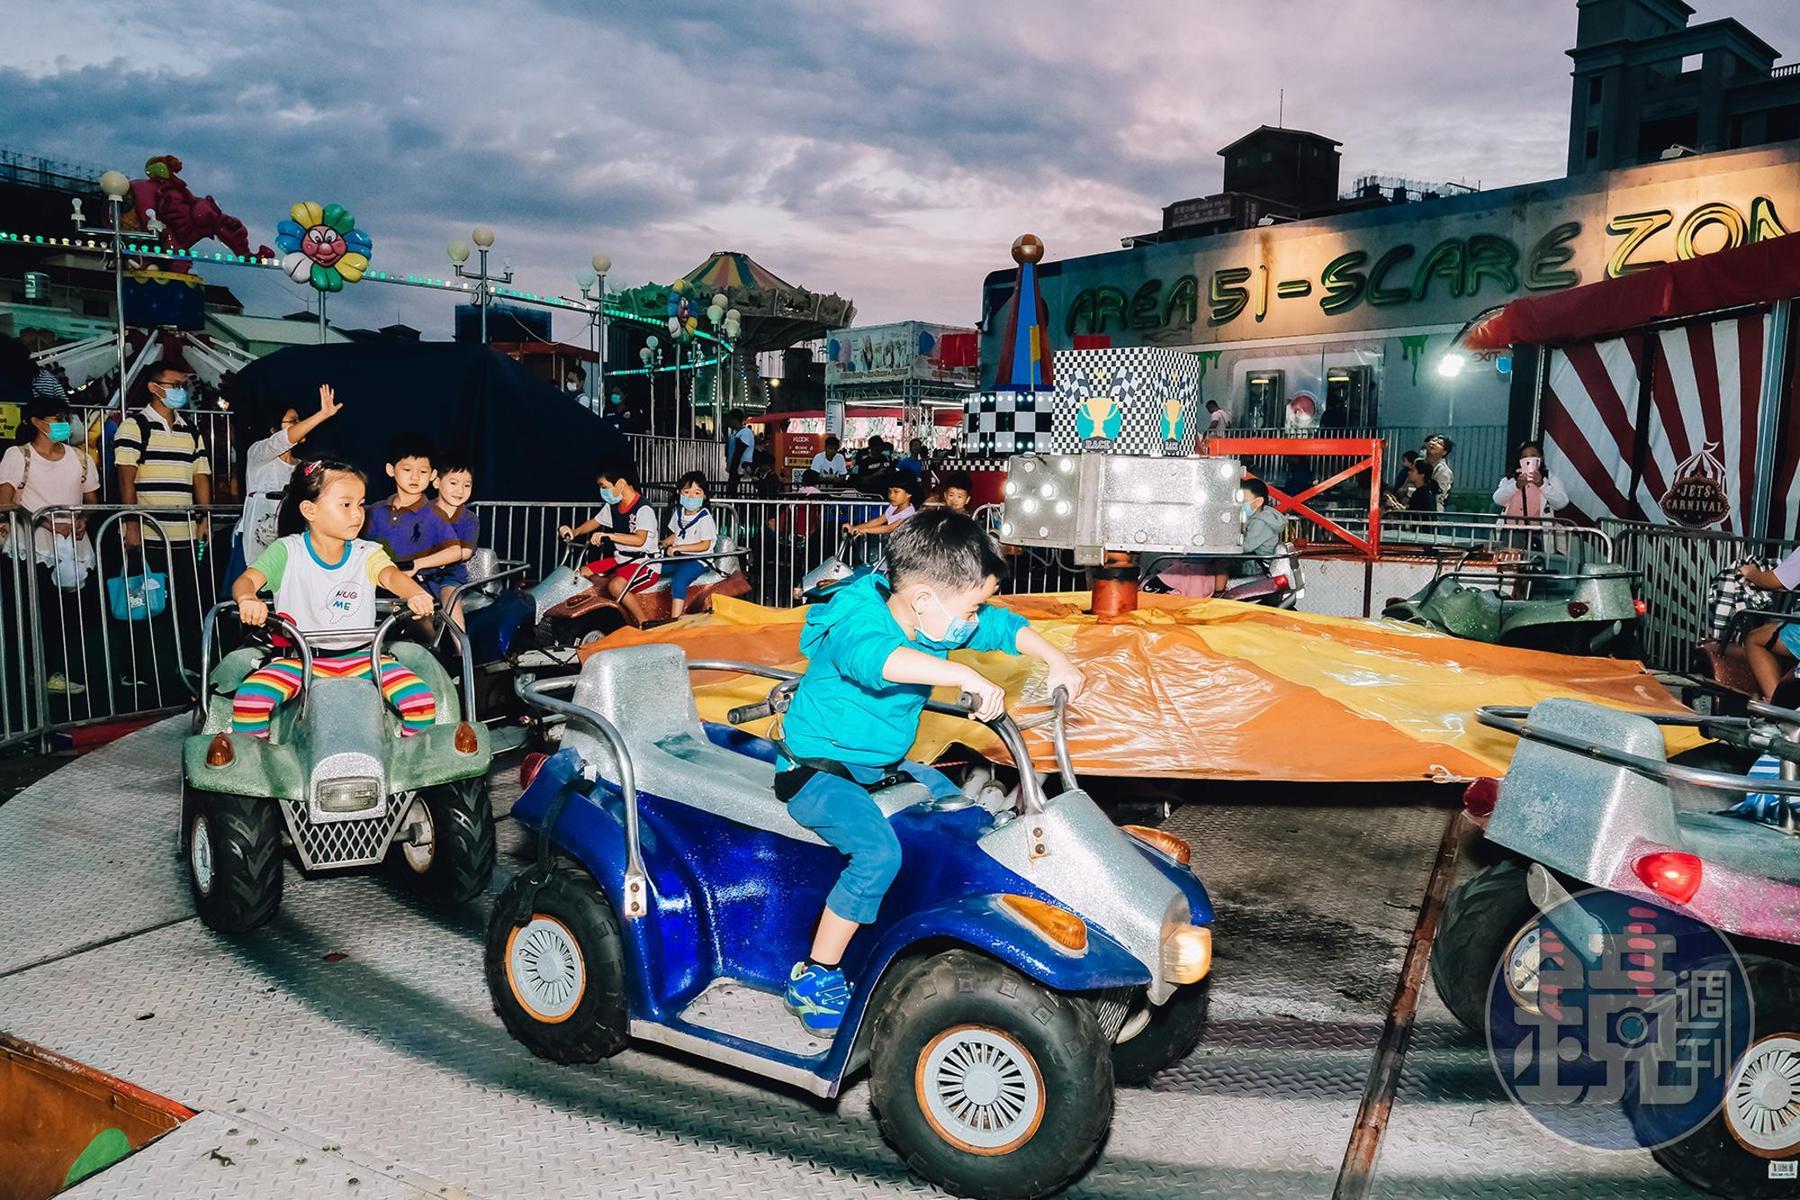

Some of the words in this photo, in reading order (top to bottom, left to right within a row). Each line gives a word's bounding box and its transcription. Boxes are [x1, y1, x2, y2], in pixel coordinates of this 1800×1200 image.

[1681, 484, 1711, 498] JETS
[1666, 499, 1723, 512] CARNIVAL
[335, 590, 358, 600] HUG
[332, 600, 352, 611] ME
